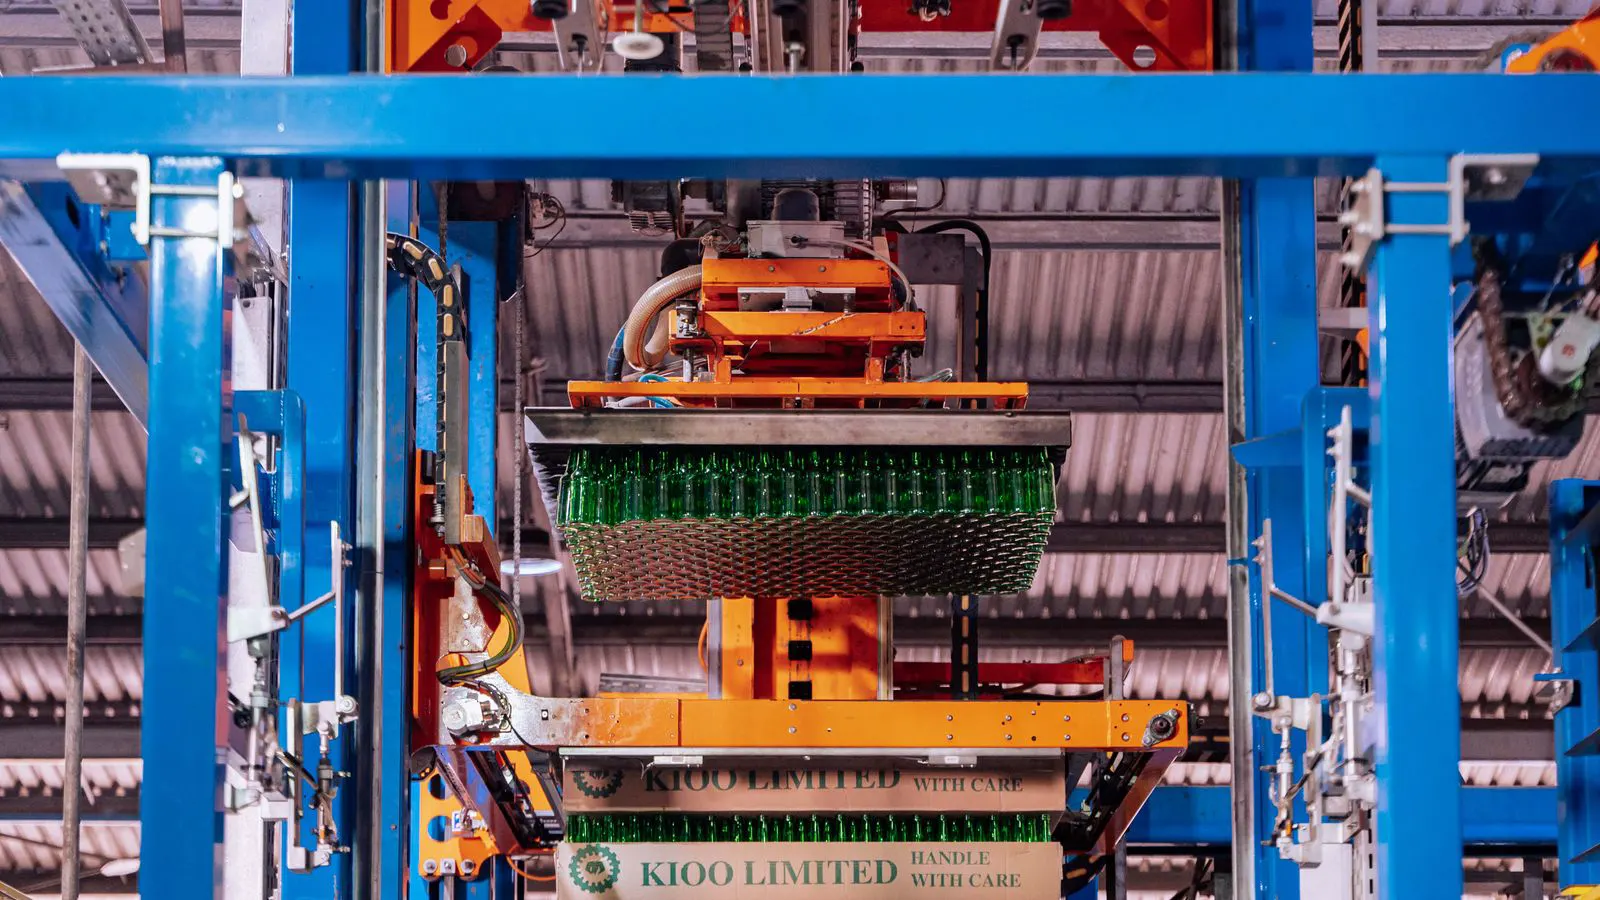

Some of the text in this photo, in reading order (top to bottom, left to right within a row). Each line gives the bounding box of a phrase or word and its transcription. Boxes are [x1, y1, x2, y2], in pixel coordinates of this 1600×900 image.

[644, 769, 901, 792] KIOO LIMITED
[914, 777, 1023, 792] WITH CARE
[911, 851, 990, 866] HANDLE
[640, 859, 898, 886] KIOO LIMITED
[911, 873, 1021, 888] WITH CARE
